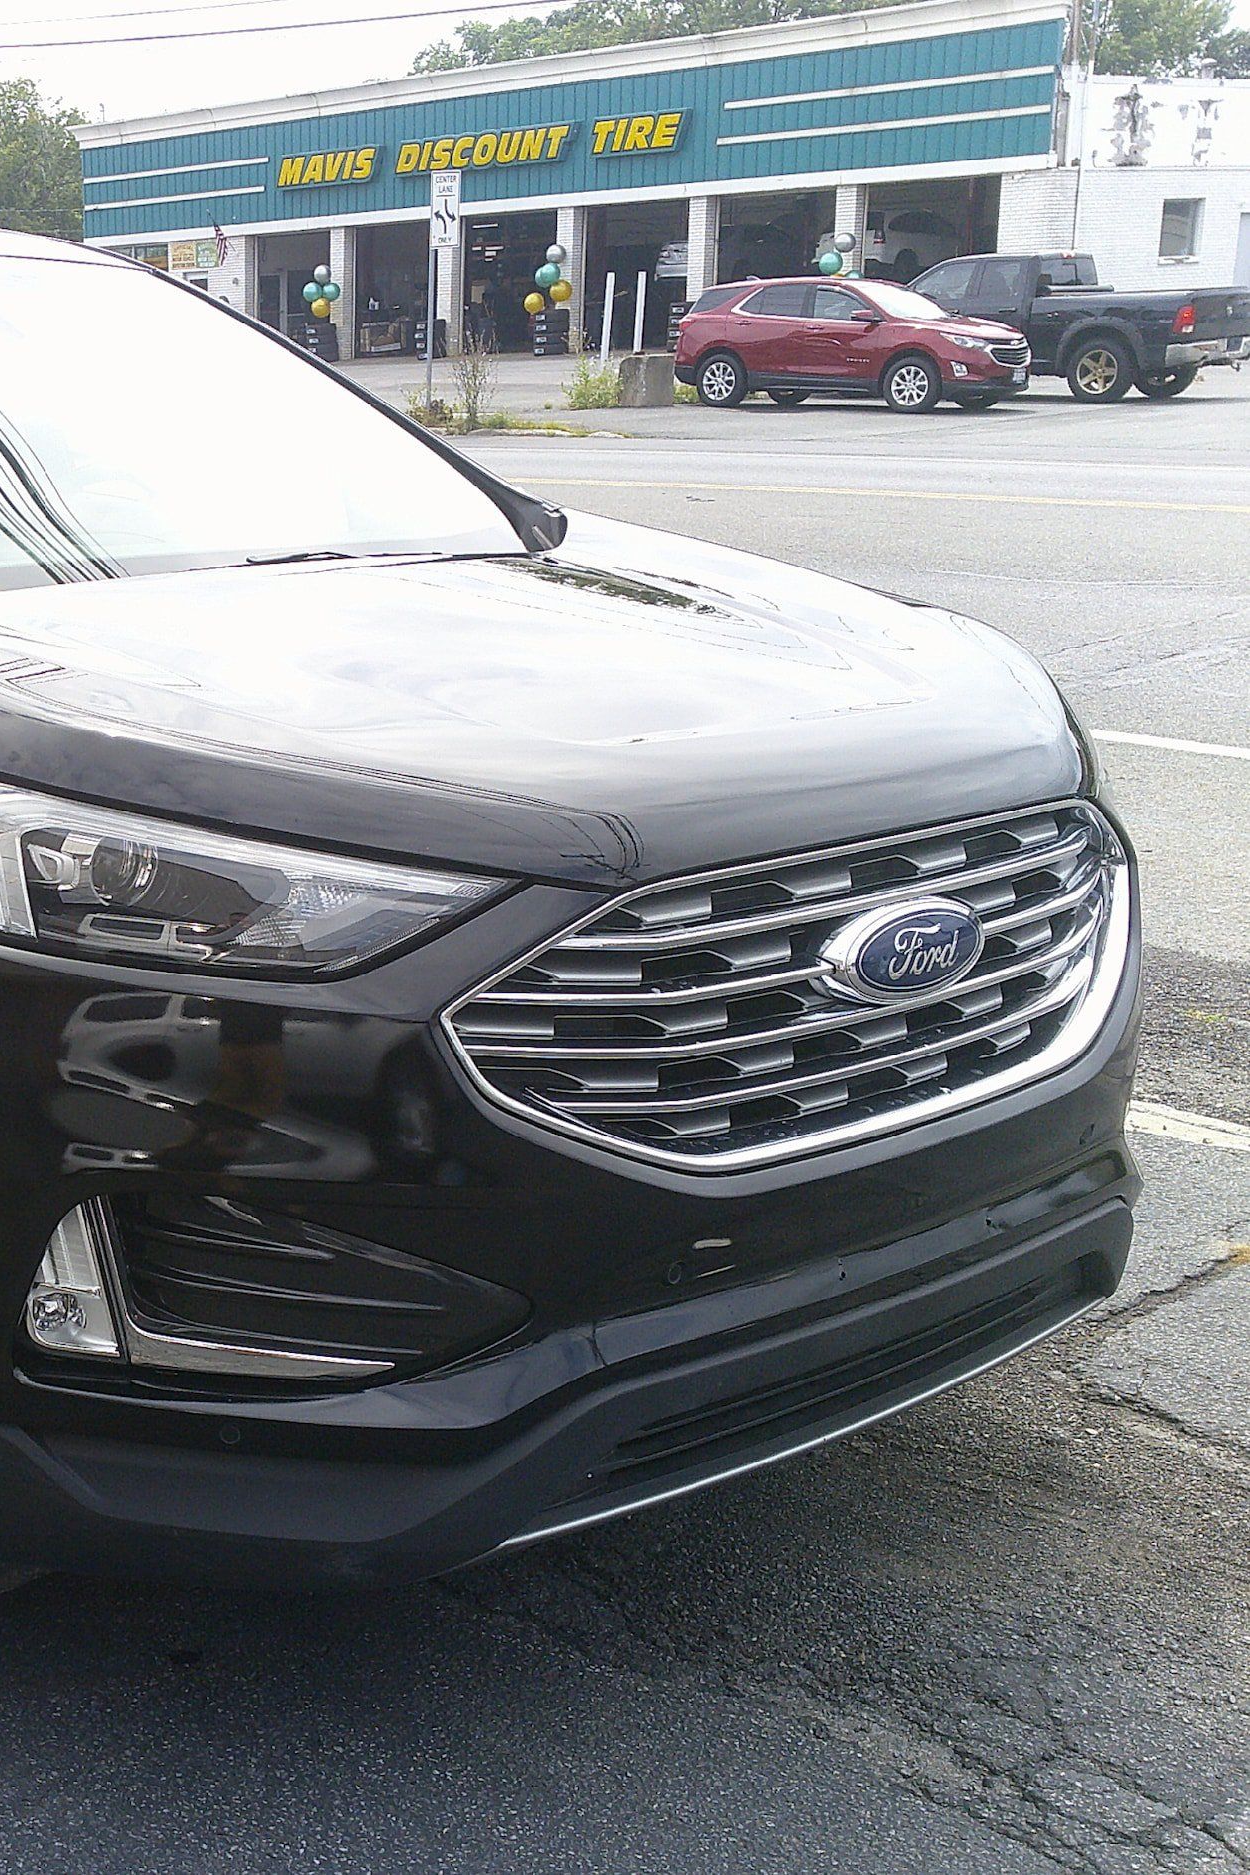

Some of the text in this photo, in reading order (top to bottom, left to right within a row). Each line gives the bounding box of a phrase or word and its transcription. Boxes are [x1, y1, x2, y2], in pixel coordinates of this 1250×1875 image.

[276, 113, 683, 187] MAVIS DISCOUNT TIRE
[435, 175, 457, 184] CENTER
[888, 922, 959, 981] Ford
